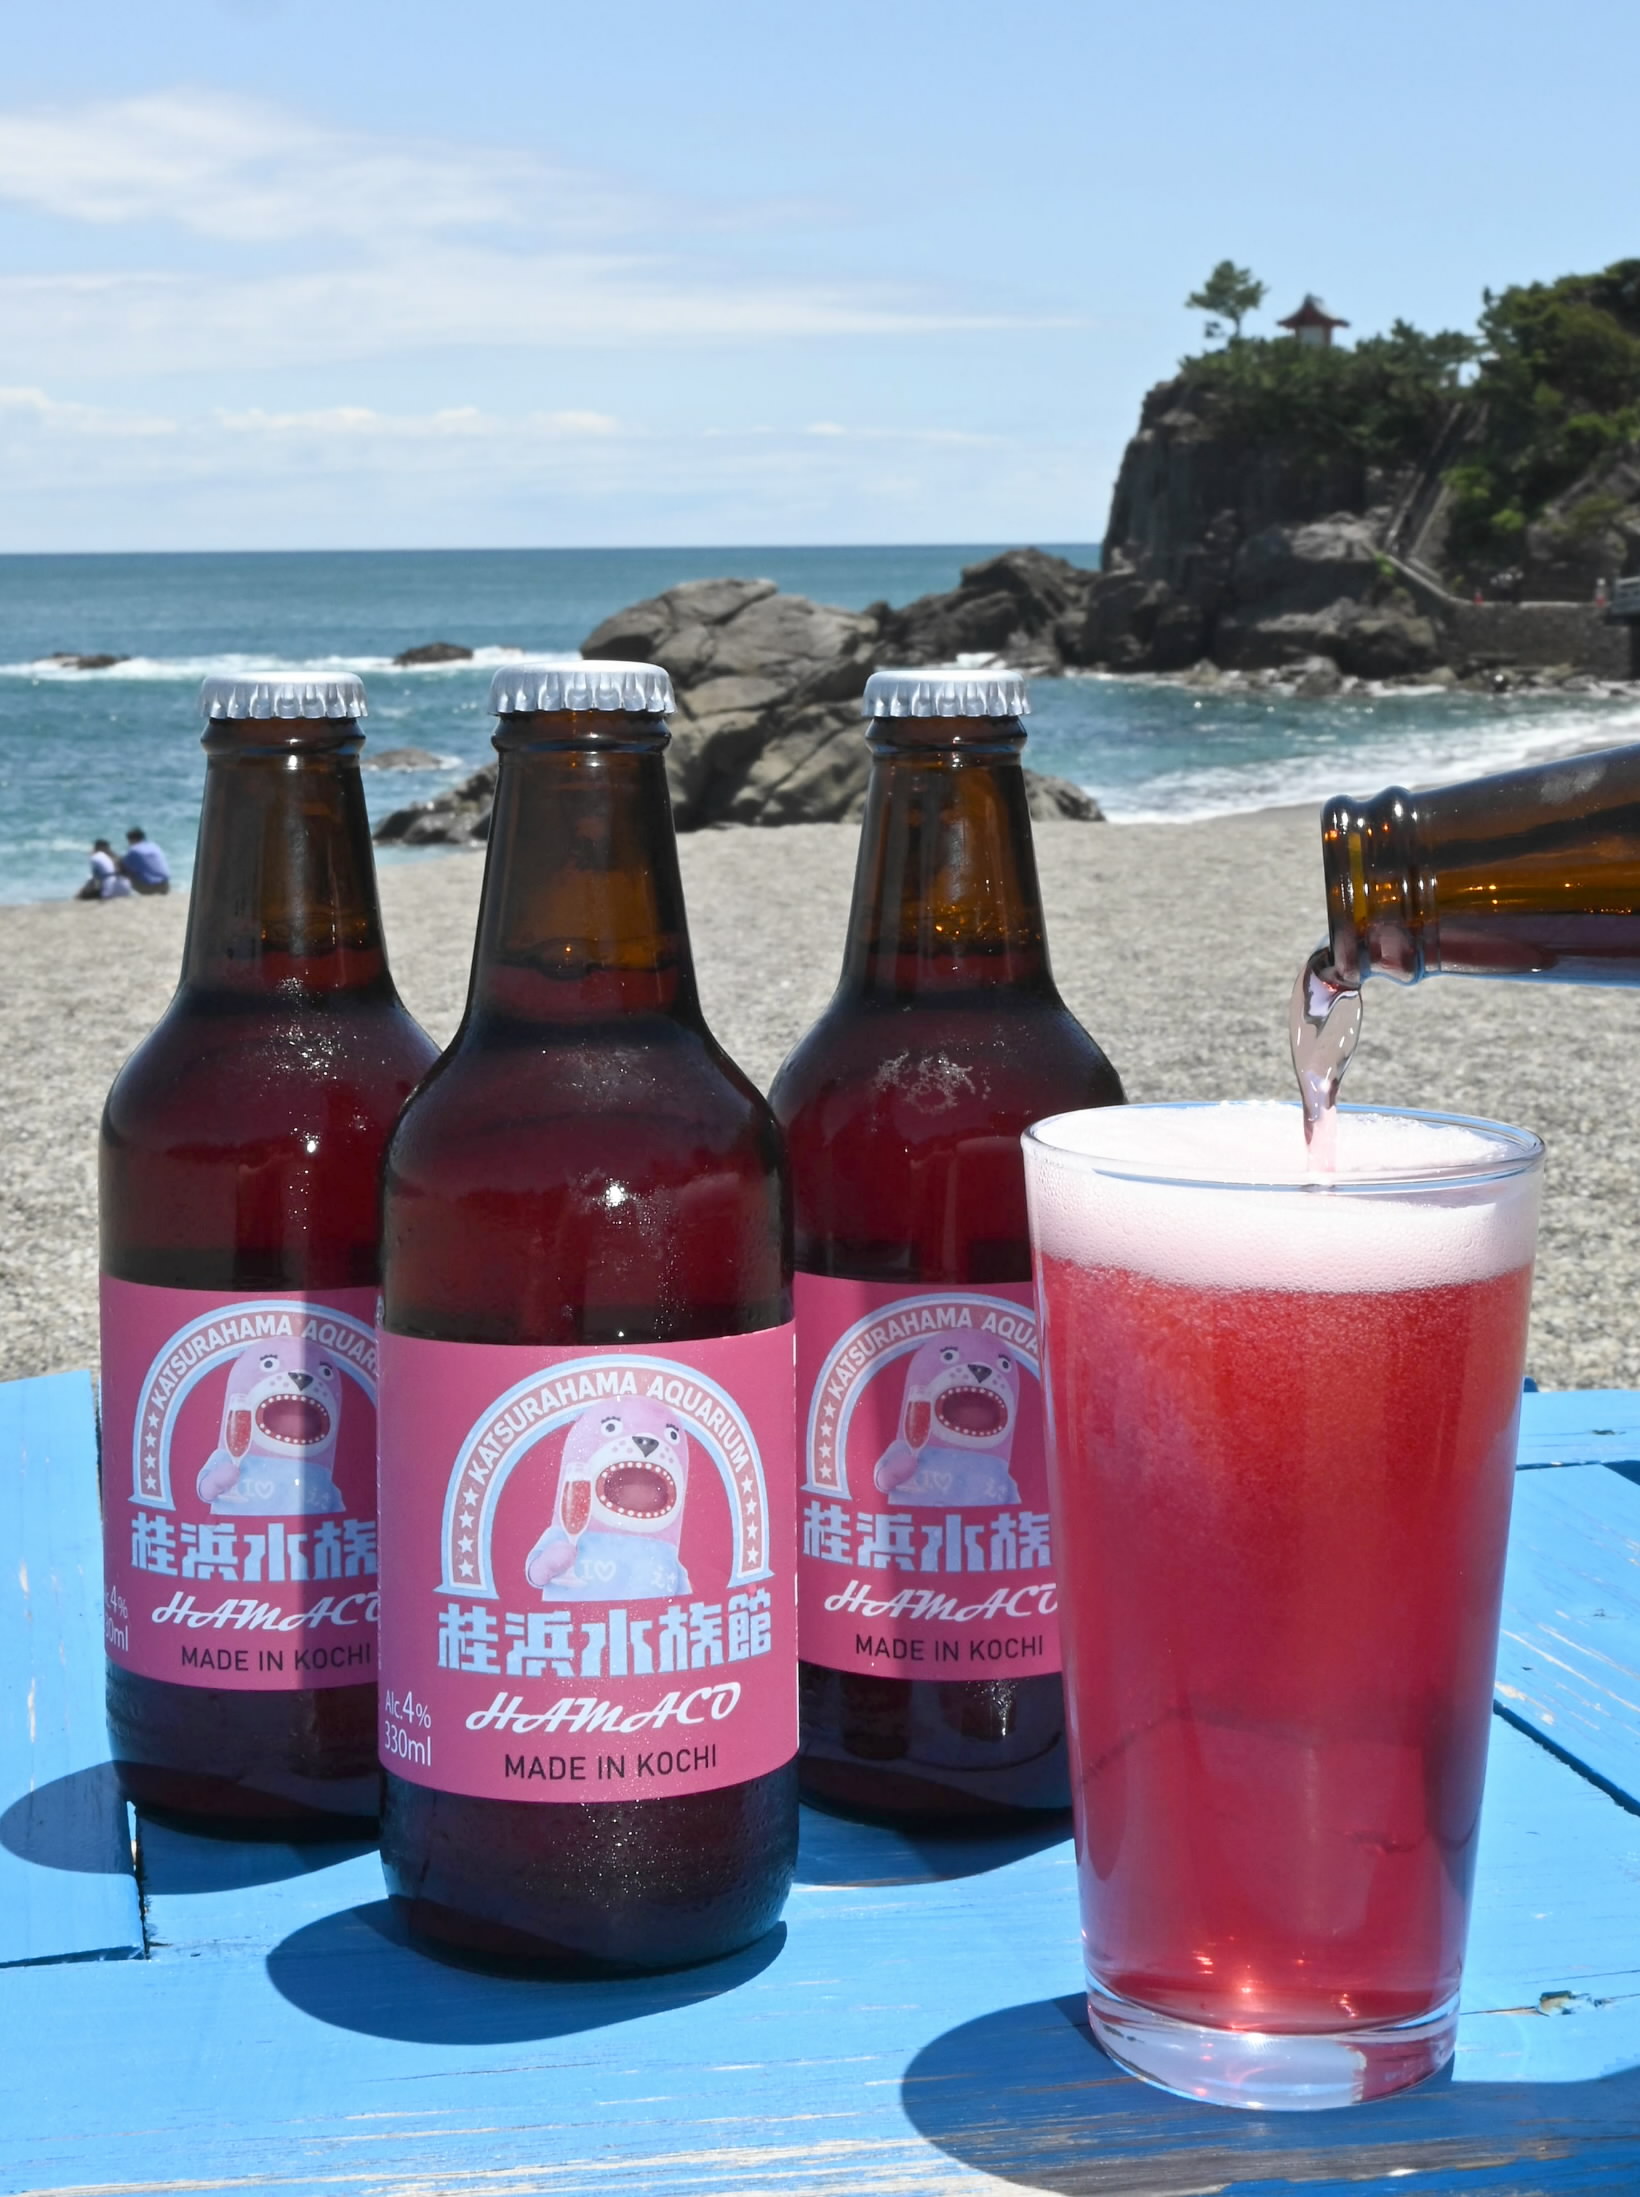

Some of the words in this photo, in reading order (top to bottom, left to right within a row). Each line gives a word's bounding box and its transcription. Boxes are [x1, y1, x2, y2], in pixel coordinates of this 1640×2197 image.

[151, 1314, 293, 1410] KATSURAHAMA
[301, 1319, 378, 1376] AQUAR
[827, 1307, 973, 1401] KATSURAHAMA
[468, 1371, 638, 1486] KATSURAHAMA
[646, 1375, 750, 1473] AQUARIUM
[131, 1512, 378, 1582] 桂浜水族
[803, 1500, 1052, 1572] 桂浜水族
[181, 1645, 249, 1672] MADE
[259, 1650, 283, 1672] IN
[295, 1643, 371, 1670] KOCHI
[438, 1587, 773, 1677] 桂浜水族館
[855, 1634, 924, 1661] MADE
[934, 1640, 959, 1662] IN
[970, 1635, 1043, 1661] KOCHI
[465, 1682, 741, 1734] HAMACO
[384, 1720, 431, 1767] 330ml
[504, 1754, 587, 1781] MADE
[598, 1755, 625, 1780] IN
[637, 1744, 717, 1776] KOCHI
